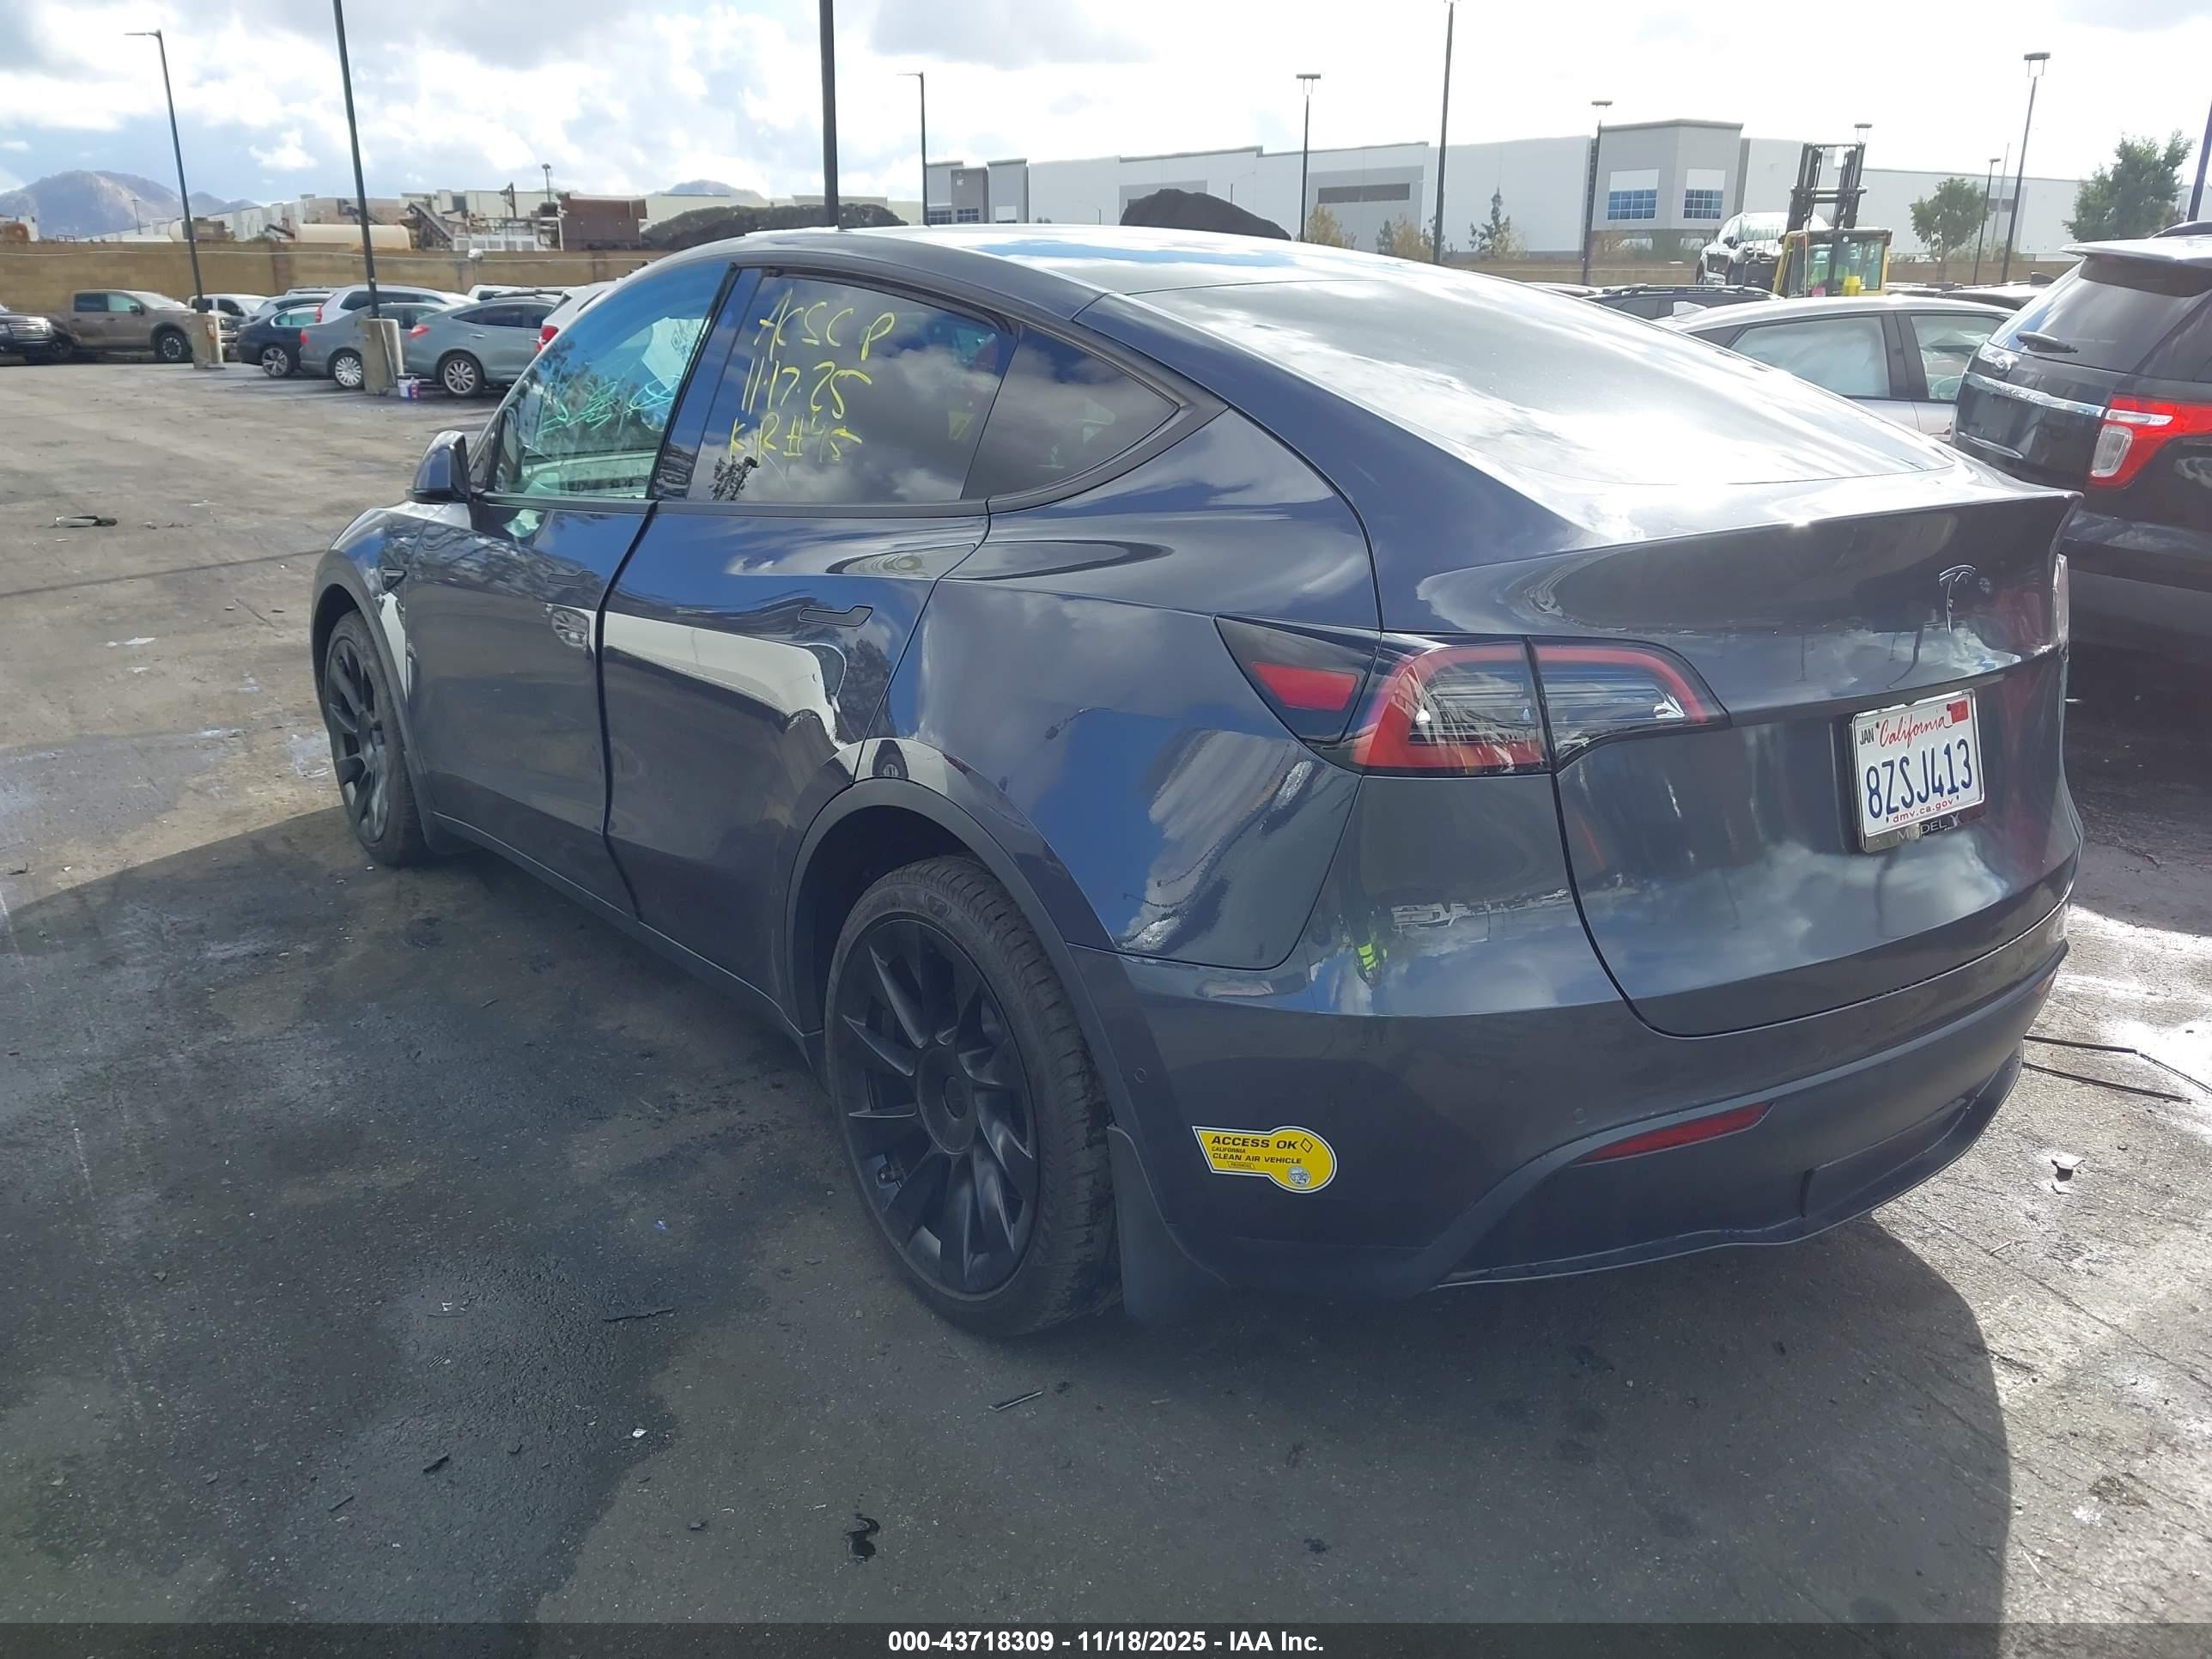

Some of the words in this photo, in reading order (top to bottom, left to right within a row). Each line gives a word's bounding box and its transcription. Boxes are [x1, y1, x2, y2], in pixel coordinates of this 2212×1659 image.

[1859, 727, 1875, 745] JAN
[1880, 714, 1953, 749] California
[1866, 738, 1973, 819] 8ZSJ413
[1893, 798, 1954, 824] dmv.ca.gov
[1212, 1135, 1270, 1149] ACCESS
[1276, 1139, 1299, 1150] OK
[1212, 1152, 1242, 1161] CLEAN
[1264, 1156, 1302, 1164] VEHICLE
